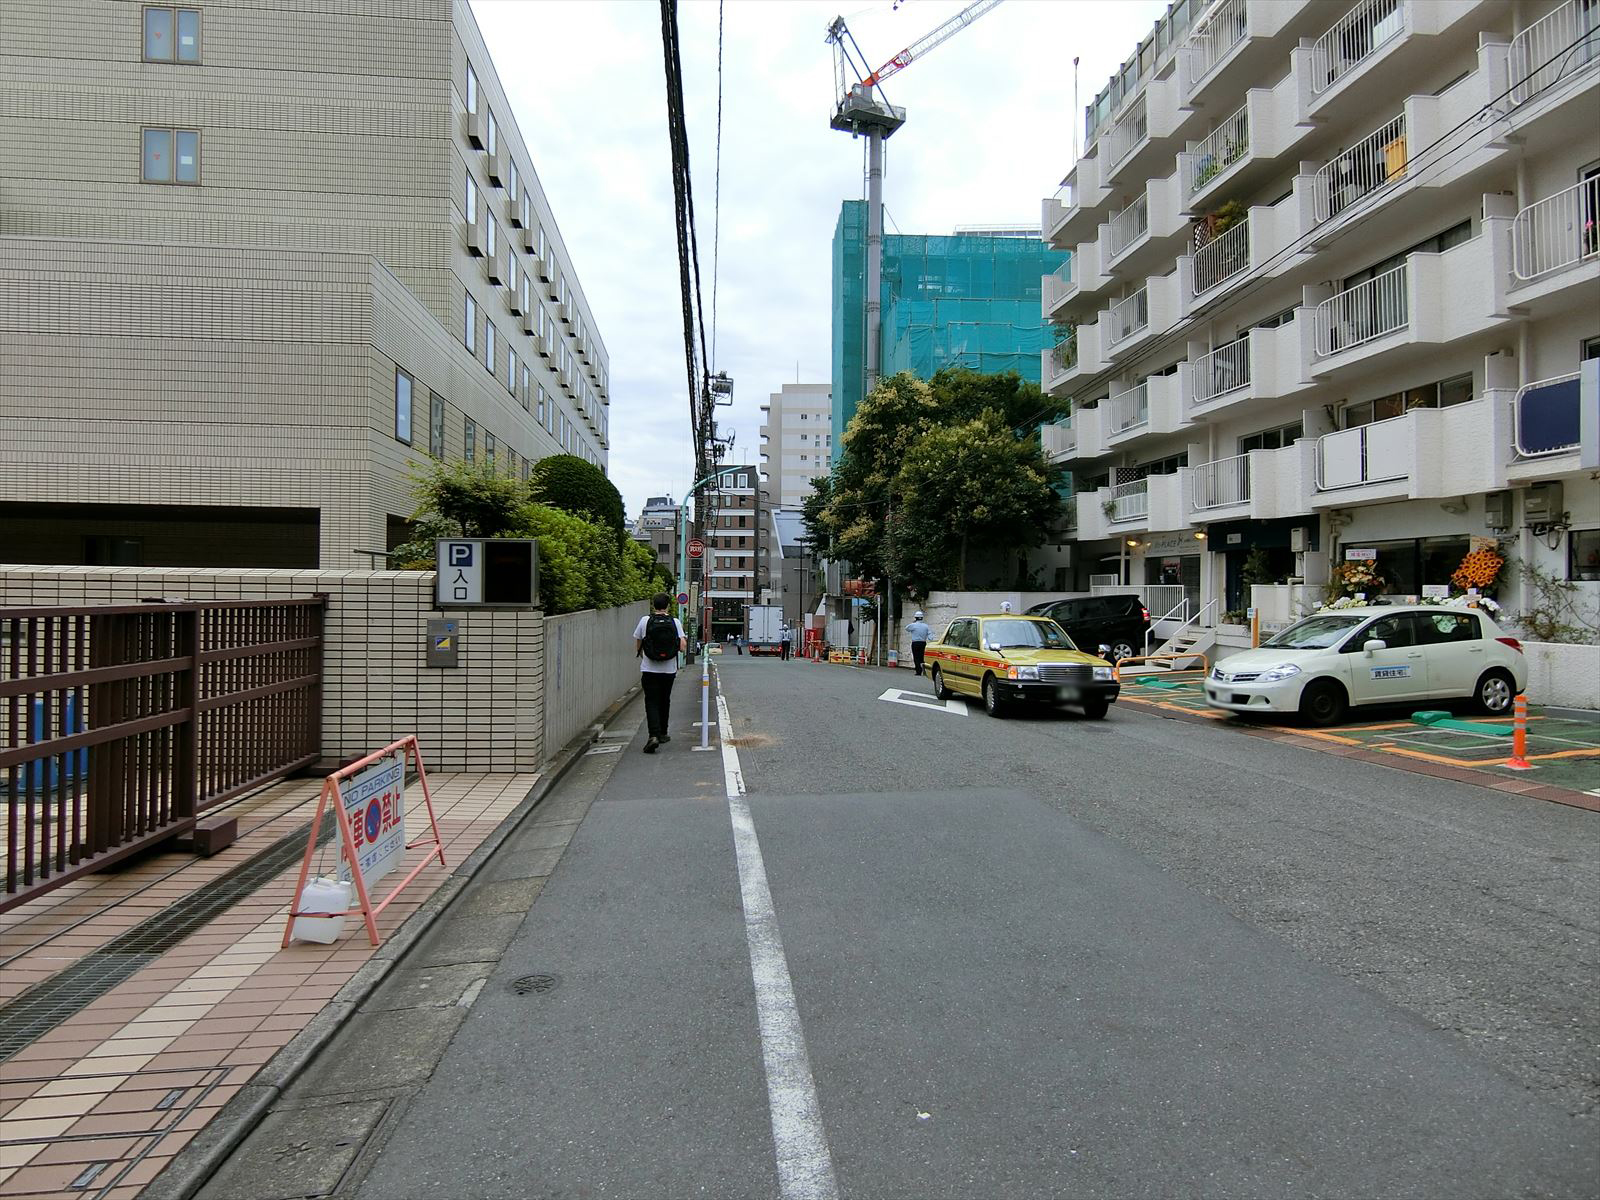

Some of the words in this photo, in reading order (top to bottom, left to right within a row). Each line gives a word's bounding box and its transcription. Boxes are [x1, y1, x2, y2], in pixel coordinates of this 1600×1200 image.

[451, 545, 470, 565] P
[453, 568, 468, 600] 入口
[343, 790, 358, 807] NO
[361, 767, 400, 797] PARKING
[382, 785, 400, 834] 禁止
